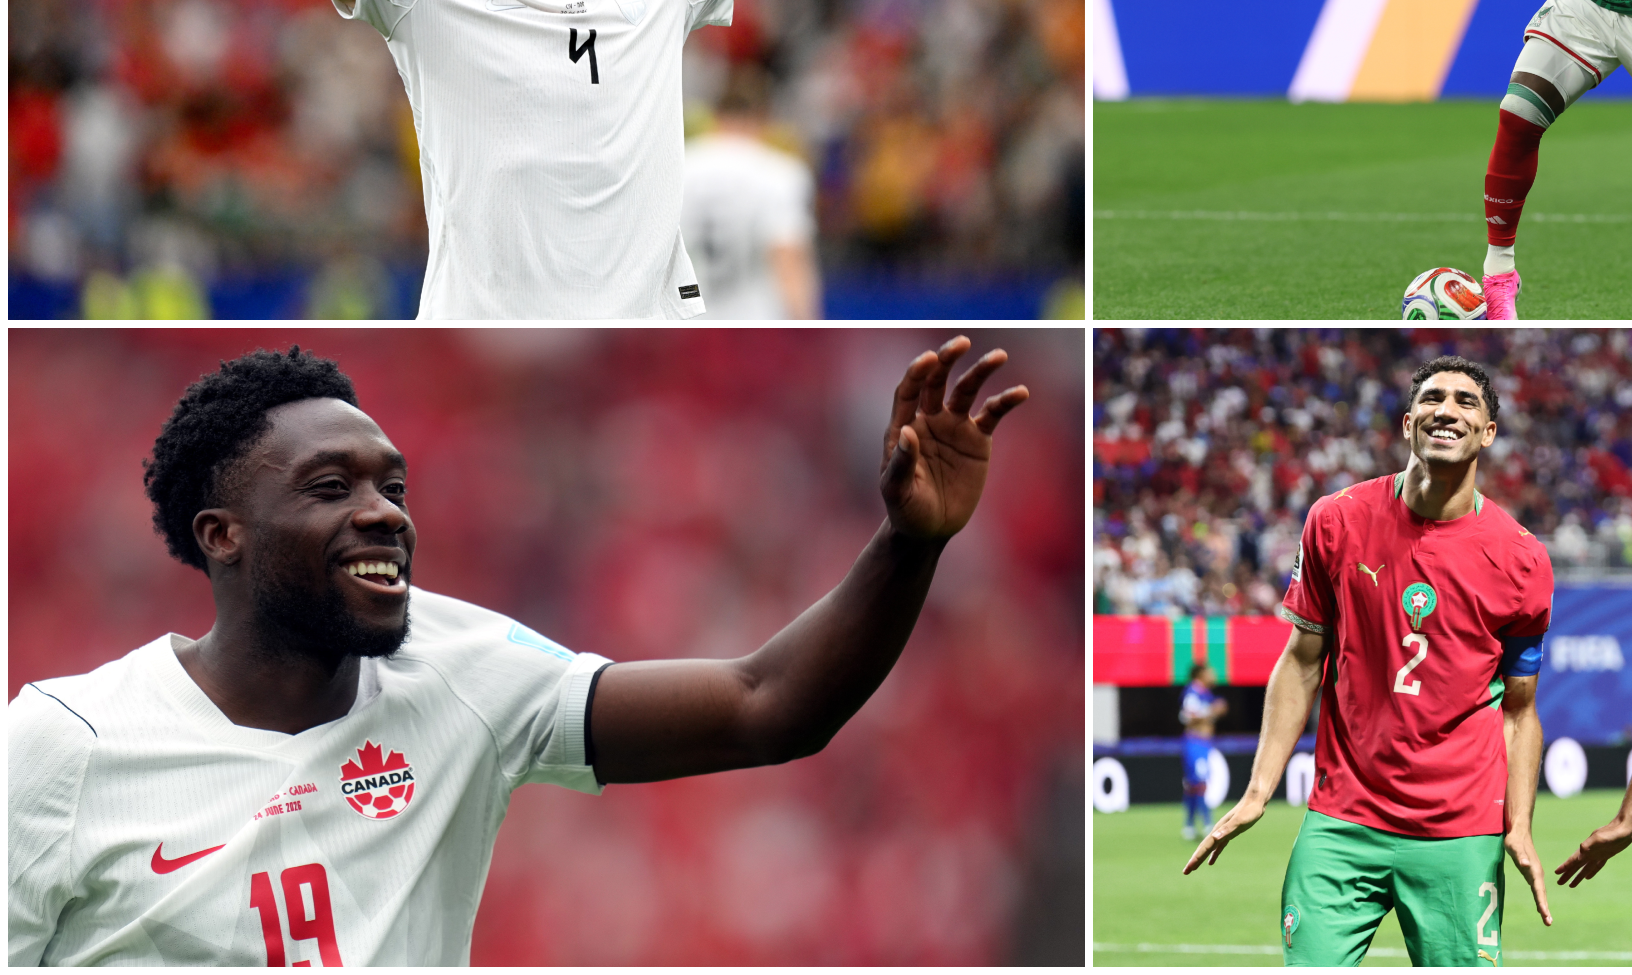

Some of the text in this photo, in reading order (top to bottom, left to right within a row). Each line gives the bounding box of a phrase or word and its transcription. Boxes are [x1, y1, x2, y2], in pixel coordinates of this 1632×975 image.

[569, 28, 599, 84] 4
[1393, 632, 1429, 696] 2
[265, 804, 284, 816] JUNE
[286, 800, 302, 812] 2026
[289, 783, 318, 796] CANADA
[341, 769, 414, 795] CANADA
[250, 862, 344, 967] 19
[1476, 882, 1498, 946] 2
